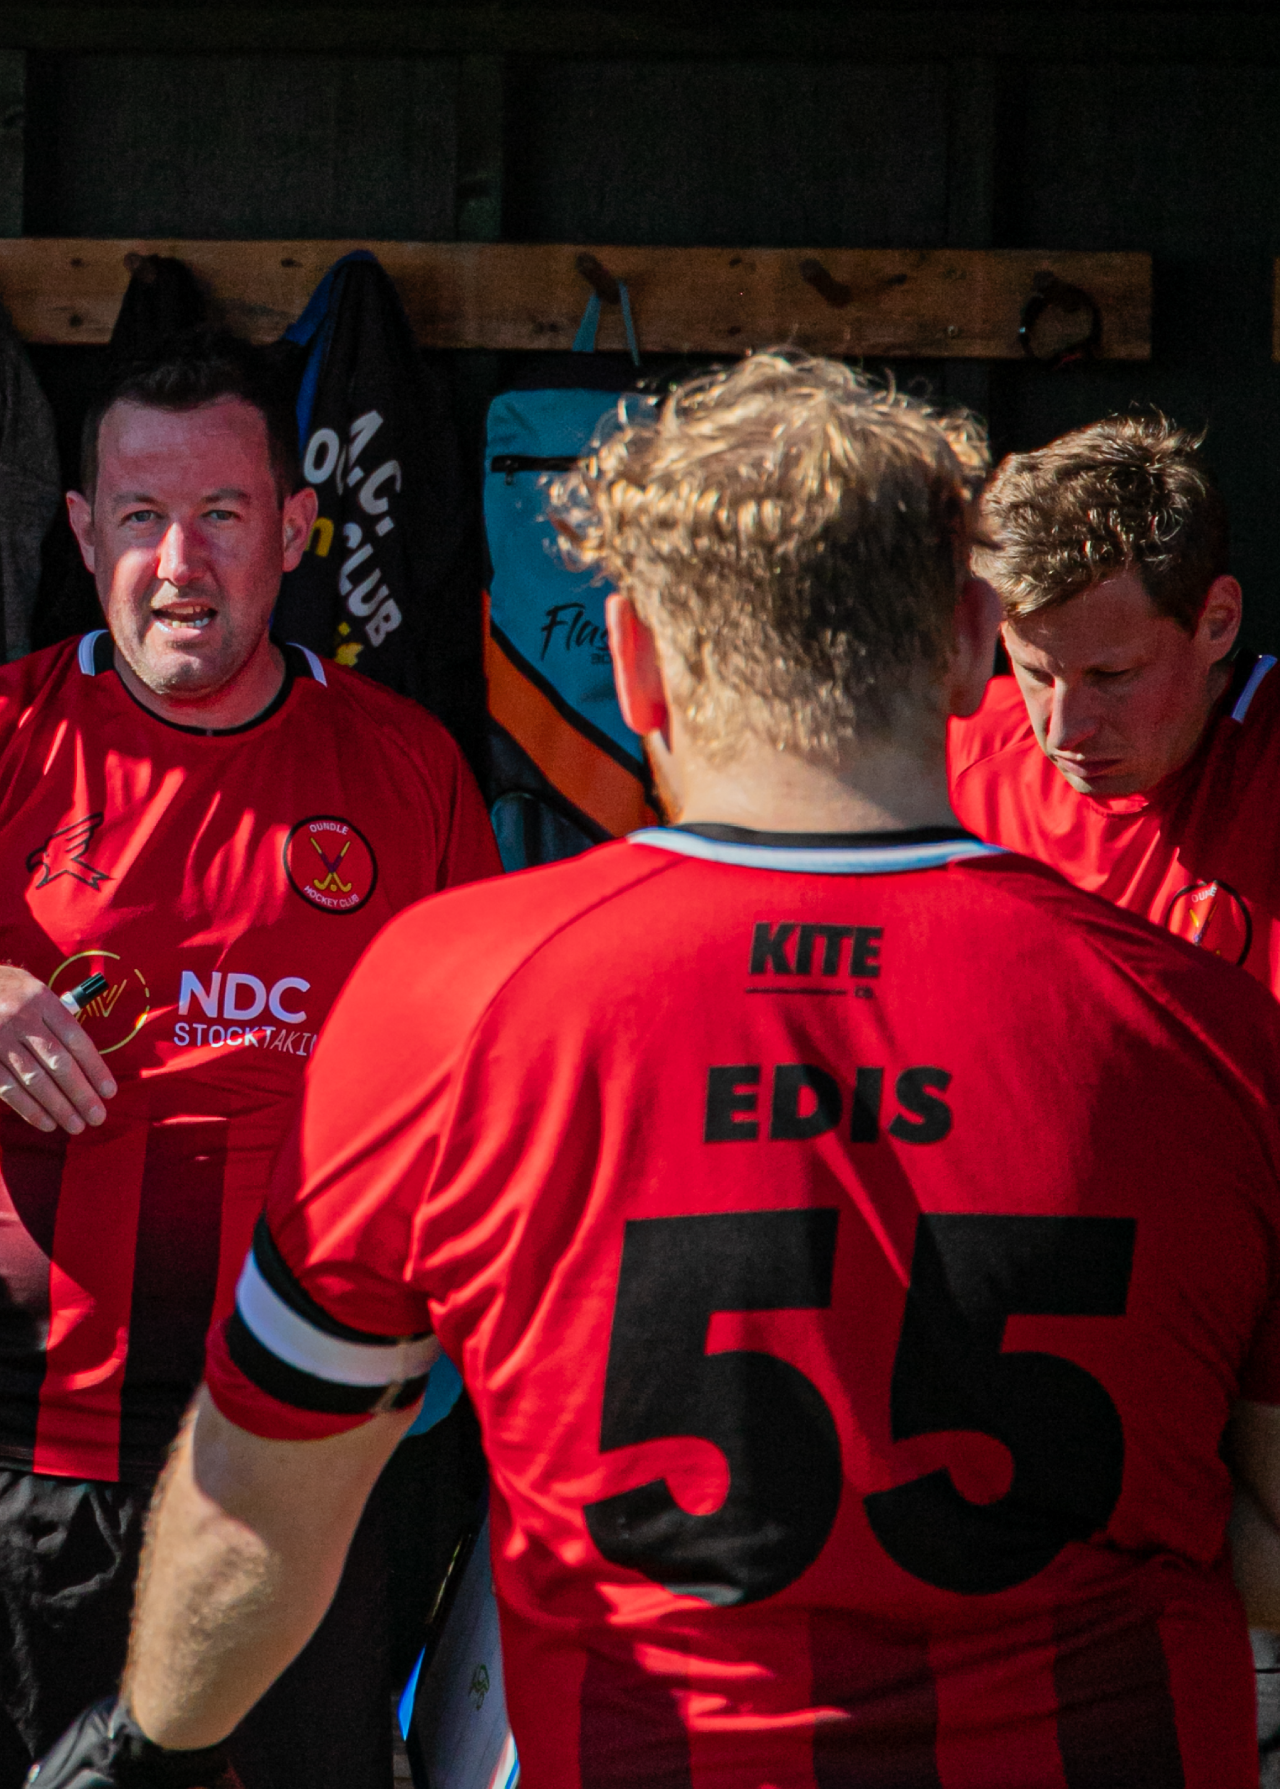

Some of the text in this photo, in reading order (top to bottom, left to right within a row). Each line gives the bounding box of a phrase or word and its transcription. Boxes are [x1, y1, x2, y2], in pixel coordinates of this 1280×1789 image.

[309, 822, 350, 835] OUNDLE
[303, 885, 360, 908] HOCKEY CLUB
[748, 920, 882, 977] KITE
[178, 970, 311, 1024] NDC
[702, 1062, 952, 1144] EDIS
[583, 1207, 1137, 1606] 55
